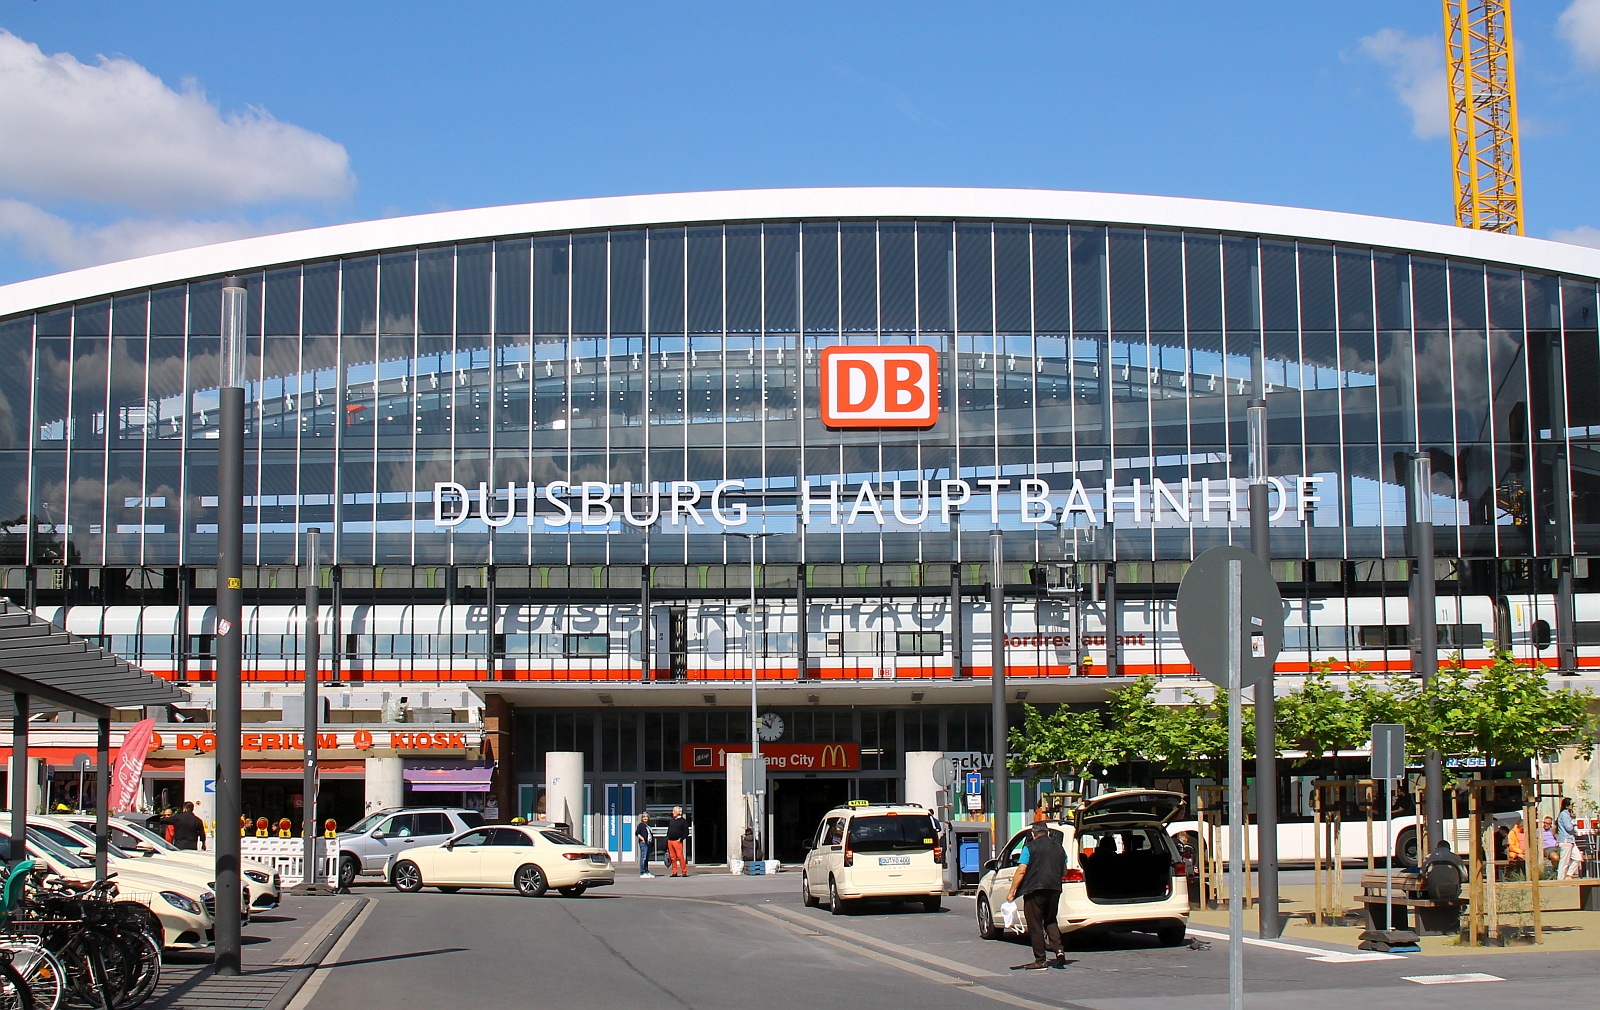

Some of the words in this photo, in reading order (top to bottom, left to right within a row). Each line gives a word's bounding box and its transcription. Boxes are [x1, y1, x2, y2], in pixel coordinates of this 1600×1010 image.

[836, 359, 925, 413] DB
[434, 480, 748, 527] DUISBURG
[802, 476, 1324, 525] HAUPTBAHNHOF
[1003, 632, 1146, 648] Bordresauant
[176, 729, 337, 752] DÖERIUM
[390, 732, 466, 749] KIOSK
[790, 753, 815, 768] City
